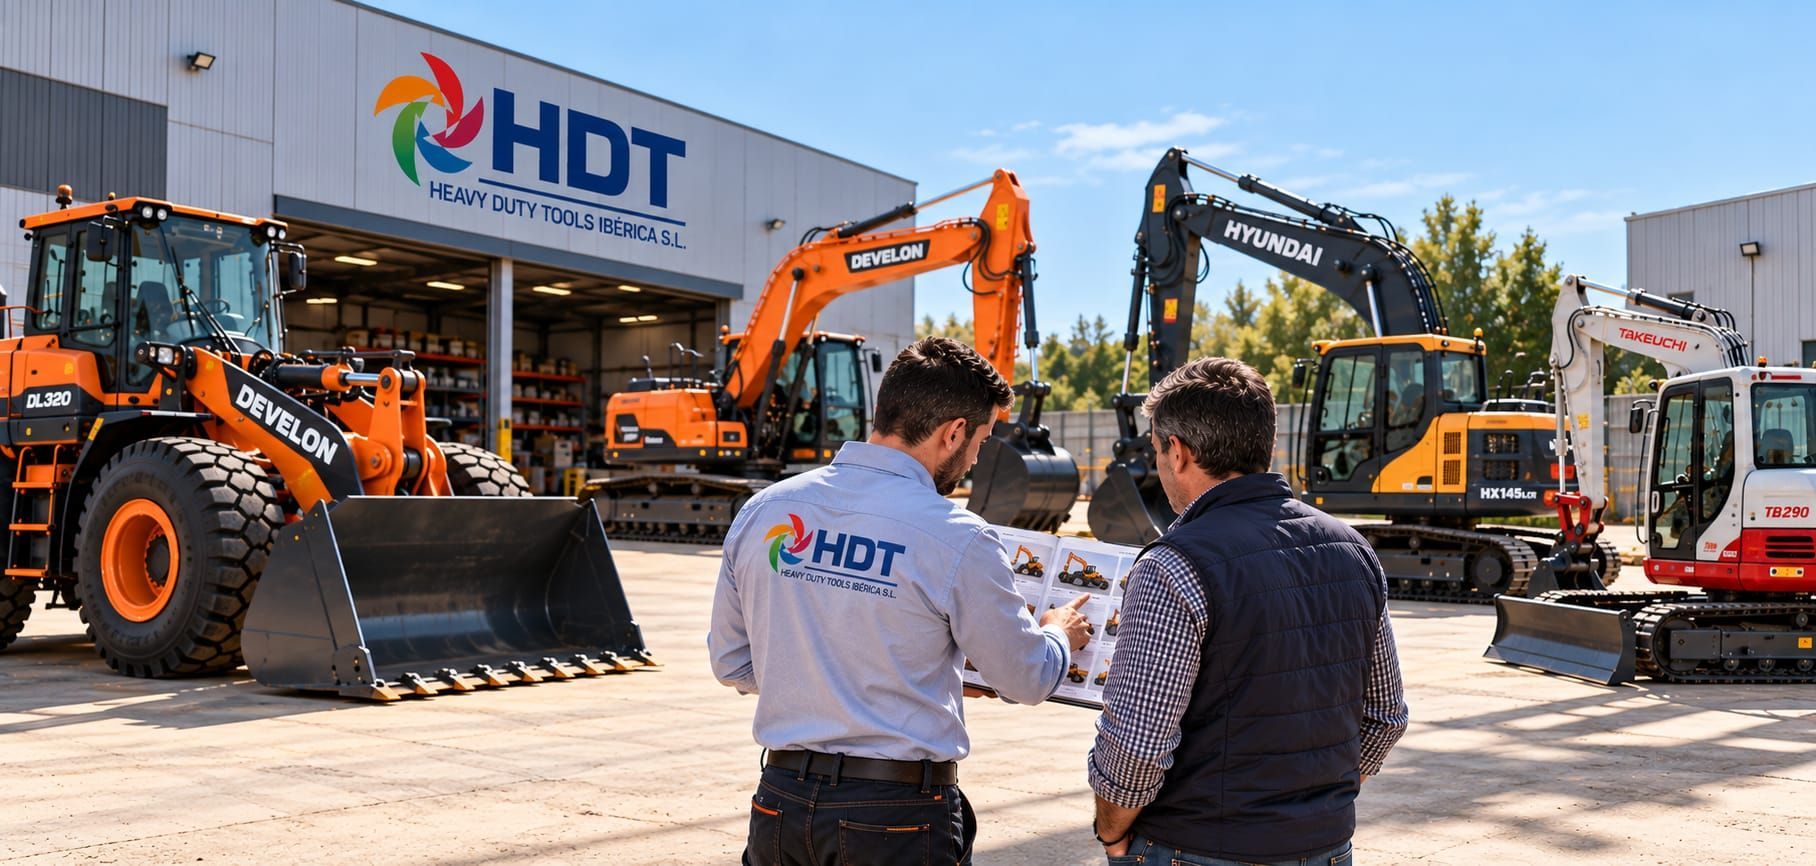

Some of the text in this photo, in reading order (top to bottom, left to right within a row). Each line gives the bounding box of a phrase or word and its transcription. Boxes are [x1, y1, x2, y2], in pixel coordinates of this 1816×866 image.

[493, 87, 686, 208] HDT
[430, 180, 687, 250] HEAVY DUTY TOOLS IBÉRICA S.L.
[851, 243, 924, 270] DEVELON
[1224, 220, 1323, 266] HYUNDAI
[1619, 327, 1687, 352] TAKEUCHI
[26, 390, 72, 409] DL320
[235, 383, 338, 465] DEVELON
[1765, 506, 1810, 518] TB290
[812, 529, 906, 577] HDT
[780, 568, 897, 599] HEAVY DUTY TOOLS IBÉRICA S.L.
